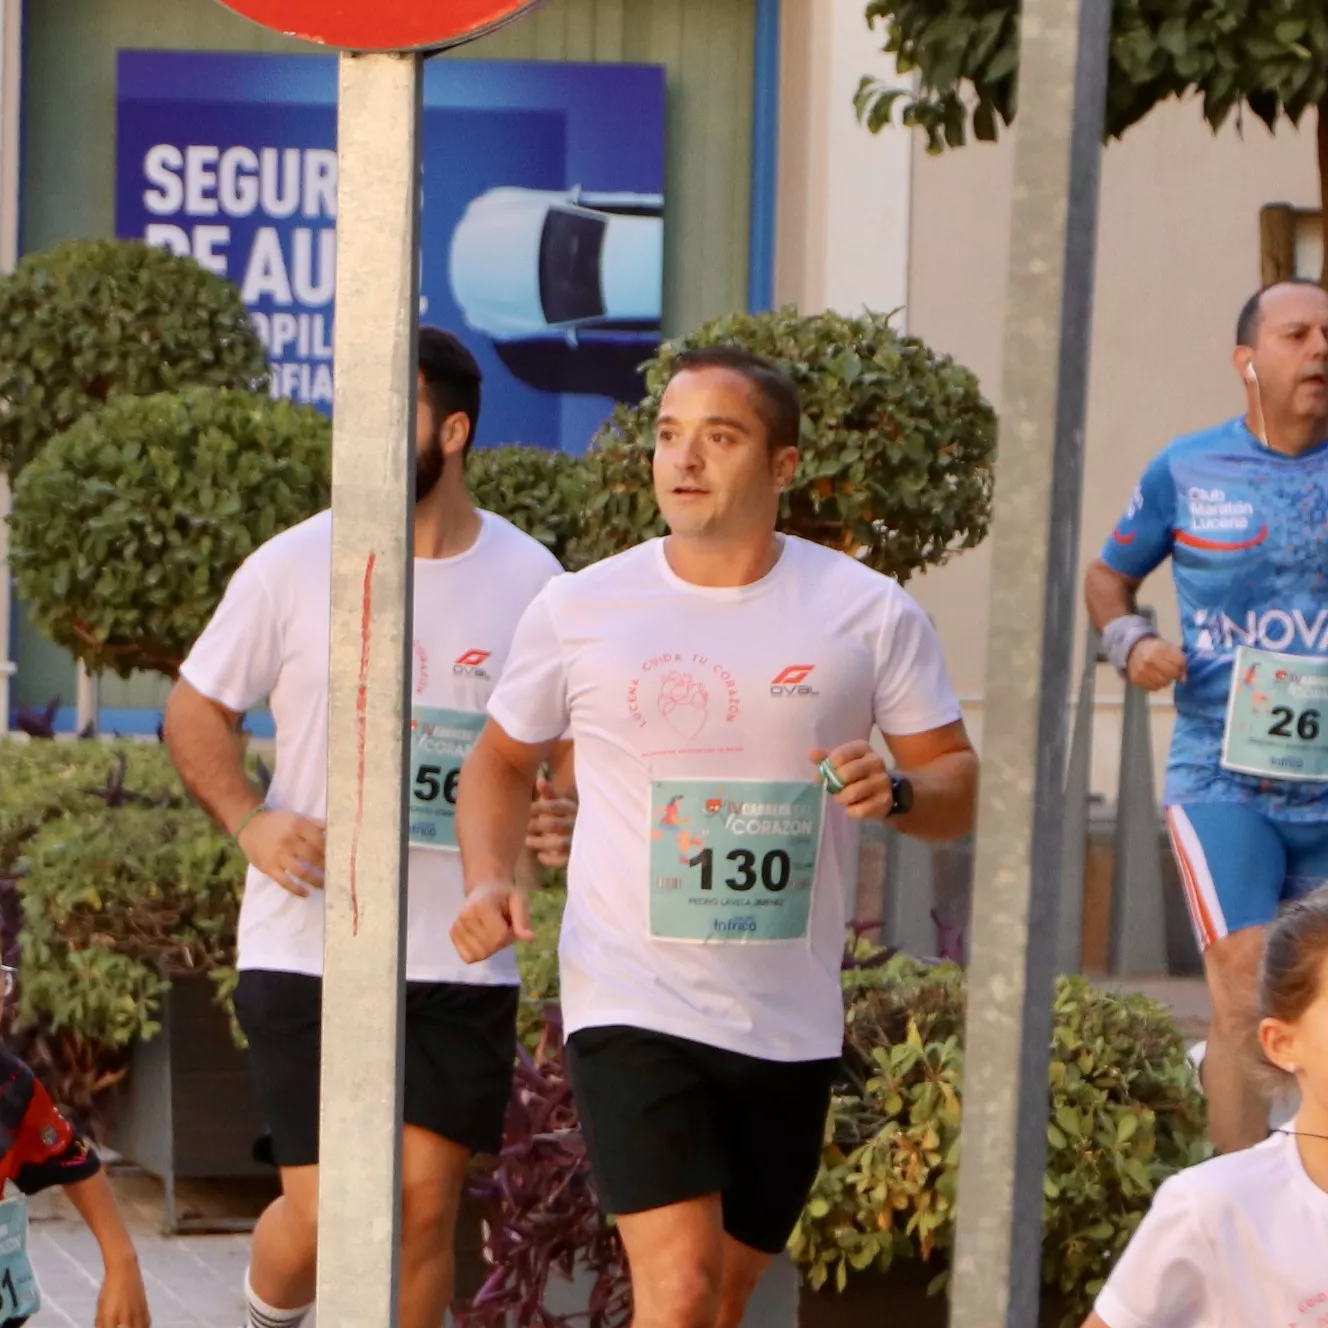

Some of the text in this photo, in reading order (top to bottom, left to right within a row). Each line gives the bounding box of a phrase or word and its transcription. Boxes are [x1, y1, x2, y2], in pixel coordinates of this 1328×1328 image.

[143, 144, 337, 219] SEGUR
[1189, 487, 1225, 501] Club
[642, 652, 682, 673] CUIDA
[1268, 705, 1321, 741] 26
[689, 848, 790, 892] 130
